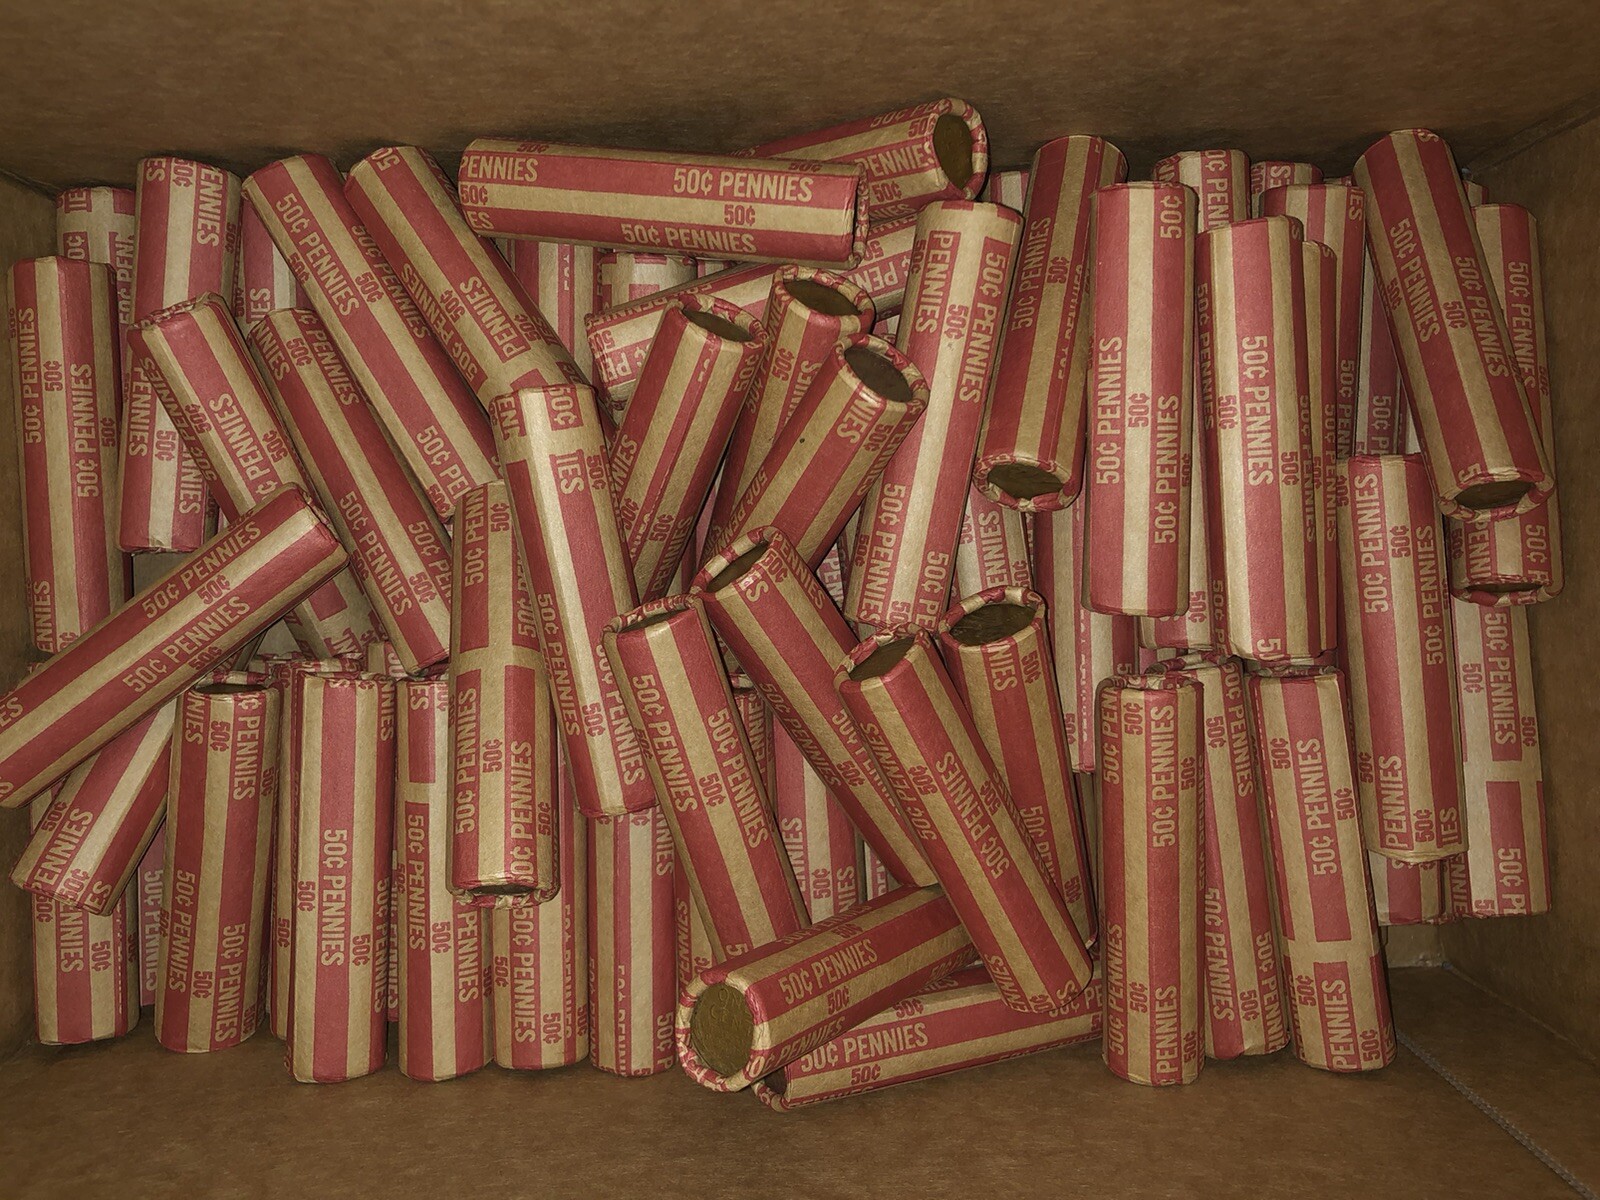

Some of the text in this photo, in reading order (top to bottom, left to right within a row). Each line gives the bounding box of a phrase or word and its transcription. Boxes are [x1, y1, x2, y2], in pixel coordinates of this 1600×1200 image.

[460, 155, 539, 182] PENNIES
[718, 176, 814, 202] PENNIES
[298, 232, 360, 317] PENNIES
[665, 229, 757, 254] PENNIES
[915, 234, 956, 334] PENNIES
[1019, 216, 1051, 290] PENNIES
[372, 260, 430, 340] PENNIES
[401, 263, 453, 345] PENNIES
[460, 276, 523, 360] PENNIES
[1400, 258, 1441, 343] PENNIES
[1467, 294, 1510, 379] PENNIES
[20, 307, 36, 399] PENNIES
[306, 328, 359, 407] PENNIES
[959, 303, 997, 403] PENNIES
[1097, 336, 1123, 435] PENNIES
[1511, 302, 1539, 389] PENNIES
[70, 363, 97, 453] PENNIES
[209, 393, 268, 483] PENNIES
[1154, 395, 1179, 494] PENNIES
[1244, 386, 1274, 487] PENNIES
[179, 520, 261, 592] PENNIES
[1355, 473, 1385, 567] PENNIES
[359, 530, 412, 617] PENNIES
[773, 532, 825, 610] PENNIES
[860, 530, 898, 623] PENNIES
[1416, 525, 1441, 620] PENNIES
[162, 595, 250, 665] PENNIES
[545, 641, 580, 737] PENNIES
[1487, 656, 1517, 746] PENNIES
[233, 716, 261, 801] PENNIES
[455, 687, 477, 785] PENNIES
[608, 686, 645, 787] PENNIES
[650, 720, 698, 813] PENNIES
[787, 715, 841, 787] PENNIES
[862, 722, 912, 804] PENNIES
[1150, 704, 1176, 802] PENNIES
[1228, 704, 1254, 798] PENNIES
[510, 740, 533, 842] PENNIES
[722, 755, 767, 847] PENNIES
[935, 751, 991, 841] PENNIES
[1296, 738, 1332, 830] PENNIES
[1379, 755, 1408, 849] PENNIES
[32, 808, 94, 893] PENNIES
[320, 873, 348, 968] PENNIES
[408, 859, 427, 951] PENNIES
[168, 911, 193, 993] PENNIES
[373, 920, 390, 1014] PENNIES
[457, 904, 479, 1003] PENNIES
[811, 938, 878, 990] PENNIES
[1106, 922, 1124, 1016] PENNIES
[1205, 931, 1236, 1022] PENNIES
[215, 961, 244, 1044] PENNIES
[512, 951, 535, 1044] PENNIES
[778, 1019, 843, 1064] PENNIES
[842, 1022, 929, 1062] PENNIES
[1155, 985, 1179, 1075] PENNIES
[1322, 978, 1349, 1072] PENNIES
